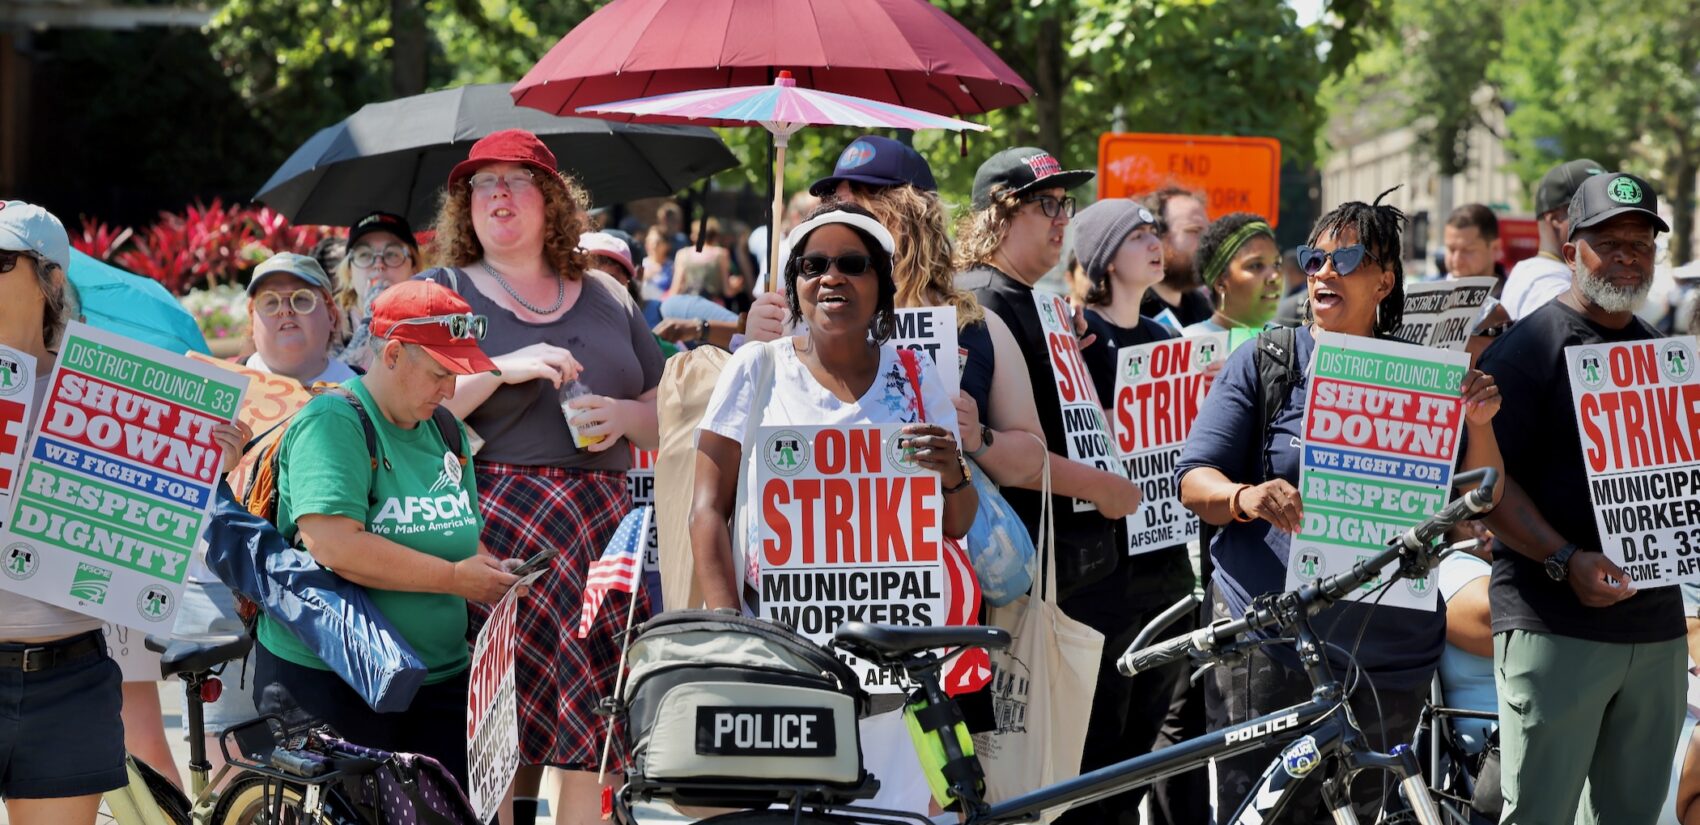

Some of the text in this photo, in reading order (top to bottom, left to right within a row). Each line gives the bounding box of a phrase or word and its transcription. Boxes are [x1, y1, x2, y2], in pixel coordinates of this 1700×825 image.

[1168, 153, 1212, 176] END
[1404, 294, 1442, 313] DISTRICT
[1470, 289, 1486, 305] 33
[68, 343, 236, 413] DISTRICT COUNCIL 33
[1149, 341, 1193, 379] ON
[1320, 351, 1463, 391] DISTRICT COUNCIL 33
[1609, 344, 1660, 388] ON
[58, 374, 217, 444] SHUT IT
[1117, 373, 1208, 453] STRIK
[1315, 381, 1457, 425] SHUT IT
[48, 402, 219, 482] DOWN!
[1311, 409, 1454, 458] DOWN!
[1580, 383, 1700, 473] STRIKE
[813, 428, 882, 475] ON
[1312, 450, 1442, 482] WE FIGHT FOR
[45, 442, 200, 505] WE FIGHT FOR
[1592, 469, 1700, 506] MUNICIPA
[26, 471, 196, 541] RESPECT
[372, 489, 474, 524] AFSCM
[1145, 501, 1178, 528] D.C.
[1306, 476, 1442, 517] RESPECT
[371, 524, 391, 535] We
[395, 522, 426, 535] Make
[428, 519, 464, 532] America
[762, 476, 938, 567] STRIKE
[1301, 512, 1414, 546] DIGNI
[1602, 500, 1700, 535] WORKER
[16, 505, 187, 577] DIGNITY
[1130, 526, 1174, 549] AFSCME
[1621, 533, 1668, 563] D.C.
[762, 570, 941, 603] MUNICIPAL
[770, 603, 933, 635] WORKERS
[469, 599, 516, 740] STRIKE
[714, 713, 818, 749] POLICE
[1225, 713, 1299, 746] POLICE
